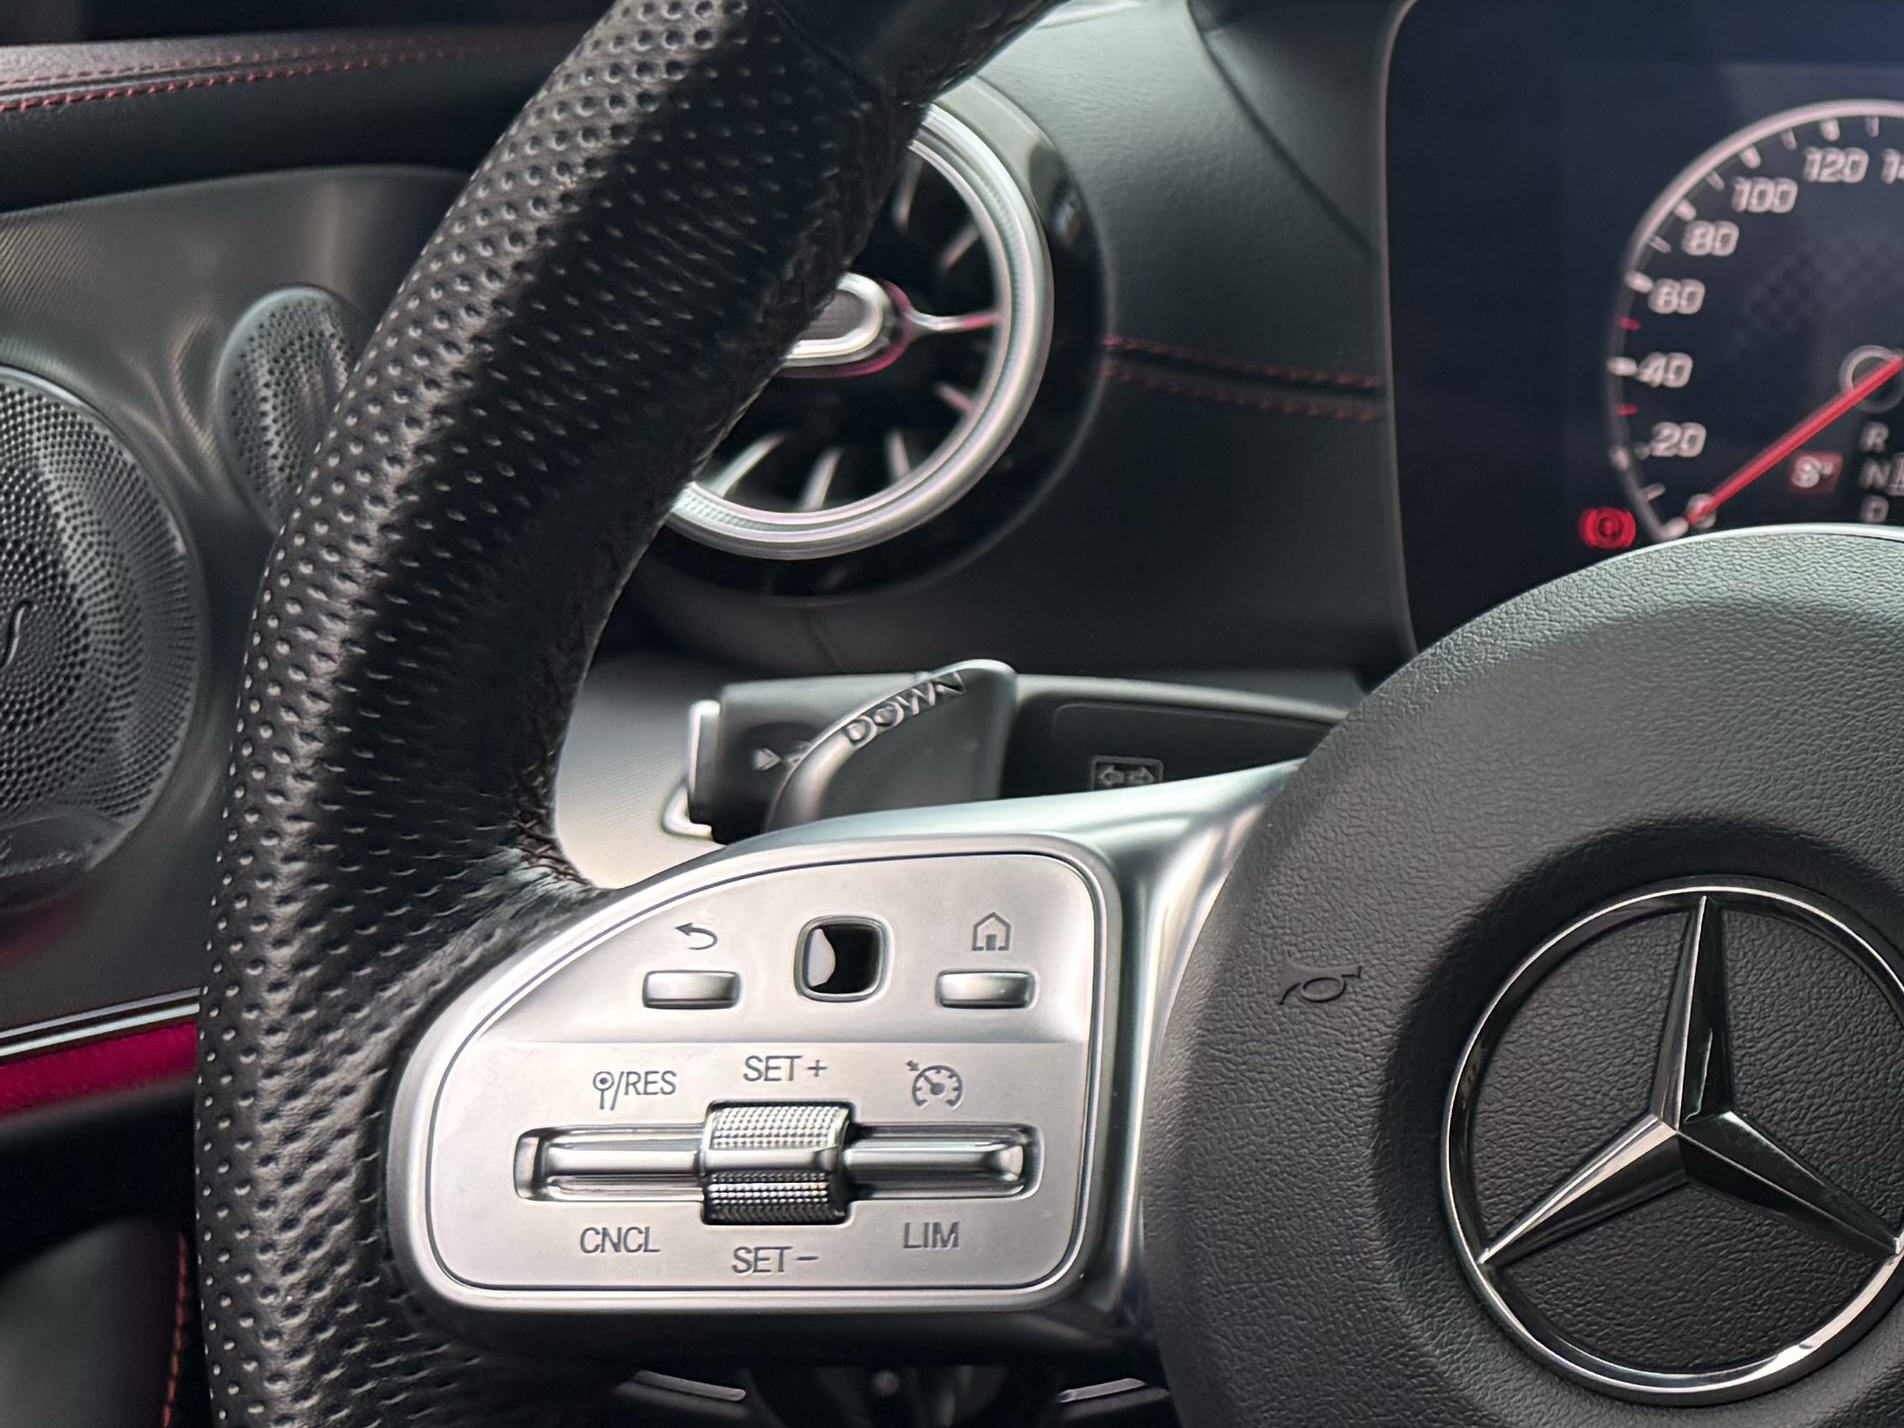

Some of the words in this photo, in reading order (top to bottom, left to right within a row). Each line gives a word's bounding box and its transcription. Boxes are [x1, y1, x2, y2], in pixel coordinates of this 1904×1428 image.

[1803, 146, 1869, 184] 120
[1731, 177, 1798, 213] 100
[1682, 220, 1739, 257] 80
[1637, 352, 1694, 389] 40
[1650, 422, 1708, 458] 20
[1859, 422, 1890, 452] R
[1859, 459, 1892, 490] N
[1860, 496, 1890, 524] D
[846, 671, 967, 751] DOWN
[578, 1224, 661, 1255] CNCL
[902, 1220, 960, 1251] LIM
